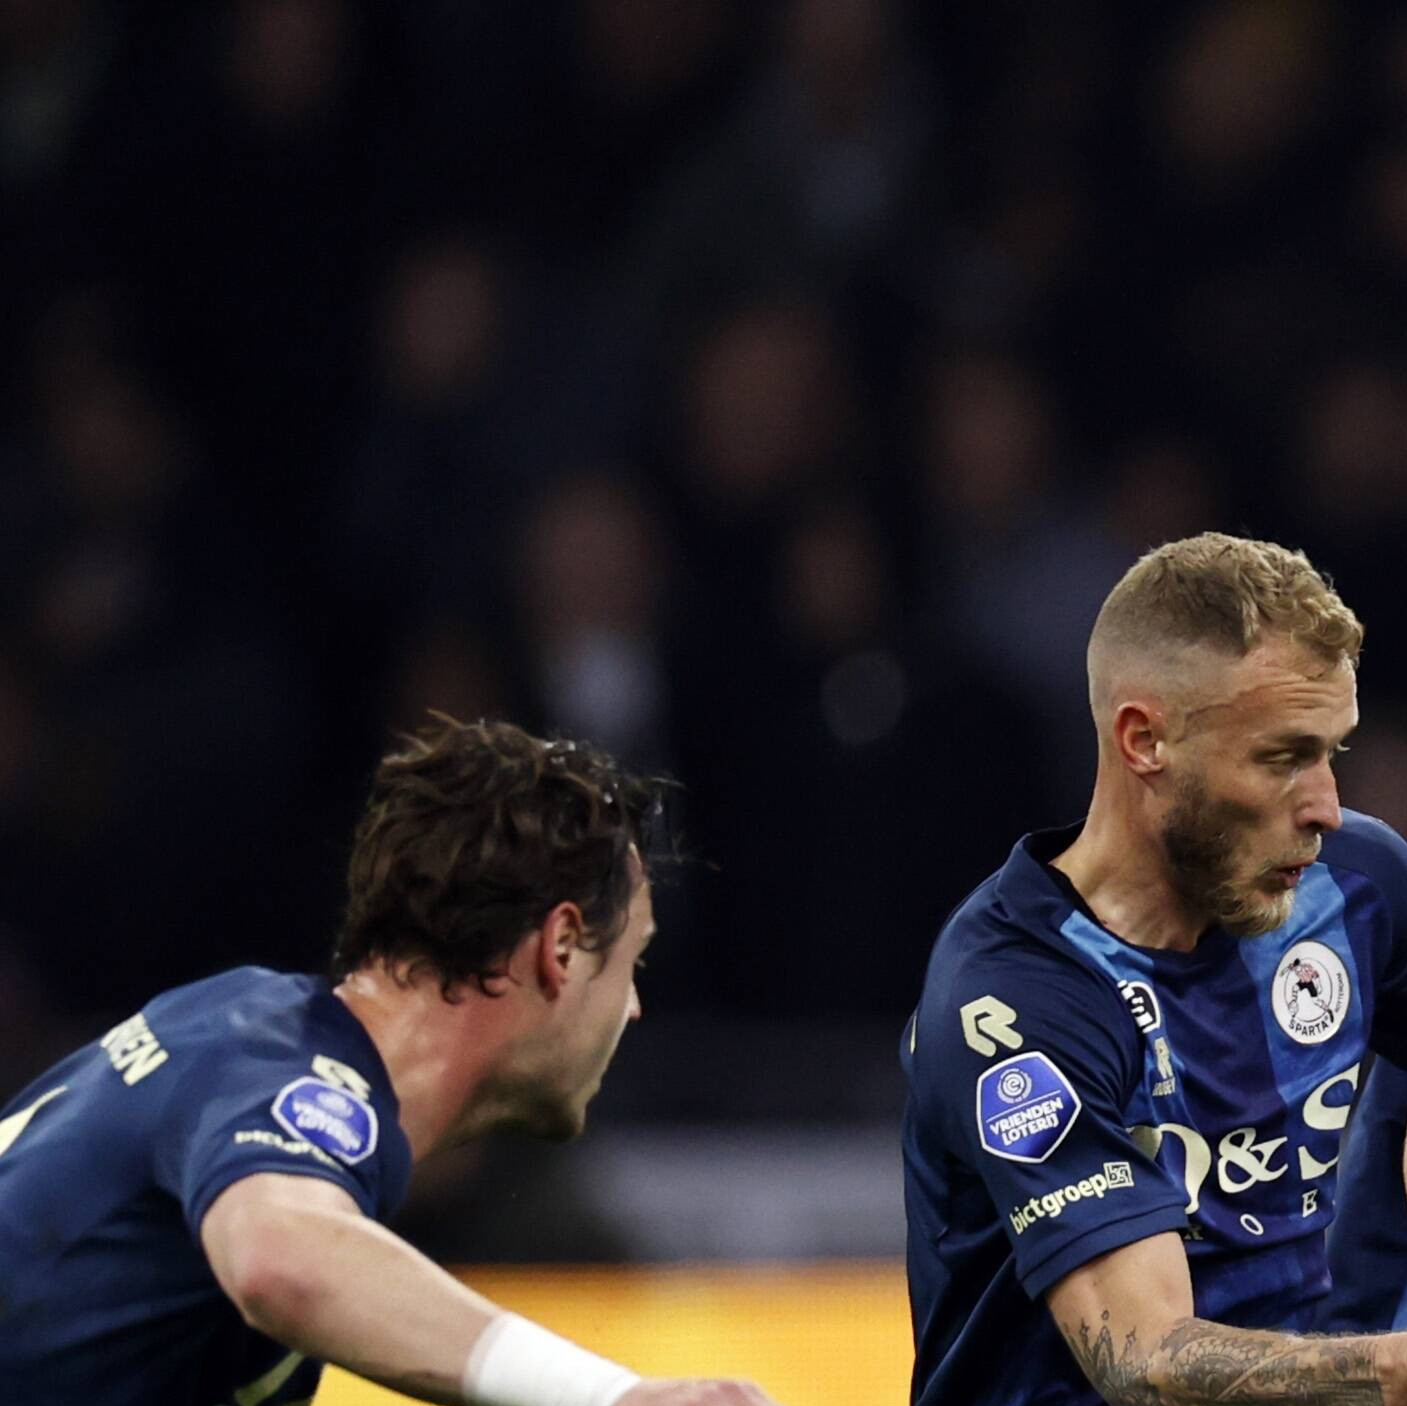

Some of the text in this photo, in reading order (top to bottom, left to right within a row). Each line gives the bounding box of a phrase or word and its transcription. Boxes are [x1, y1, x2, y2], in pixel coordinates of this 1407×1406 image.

[1288, 1018, 1329, 1037] SPARTA
[989, 1096, 1064, 1136] VRIENDEN
[1001, 1112, 1060, 1147] LOTERIJ
[1008, 1171, 1109, 1235] bictgroep
